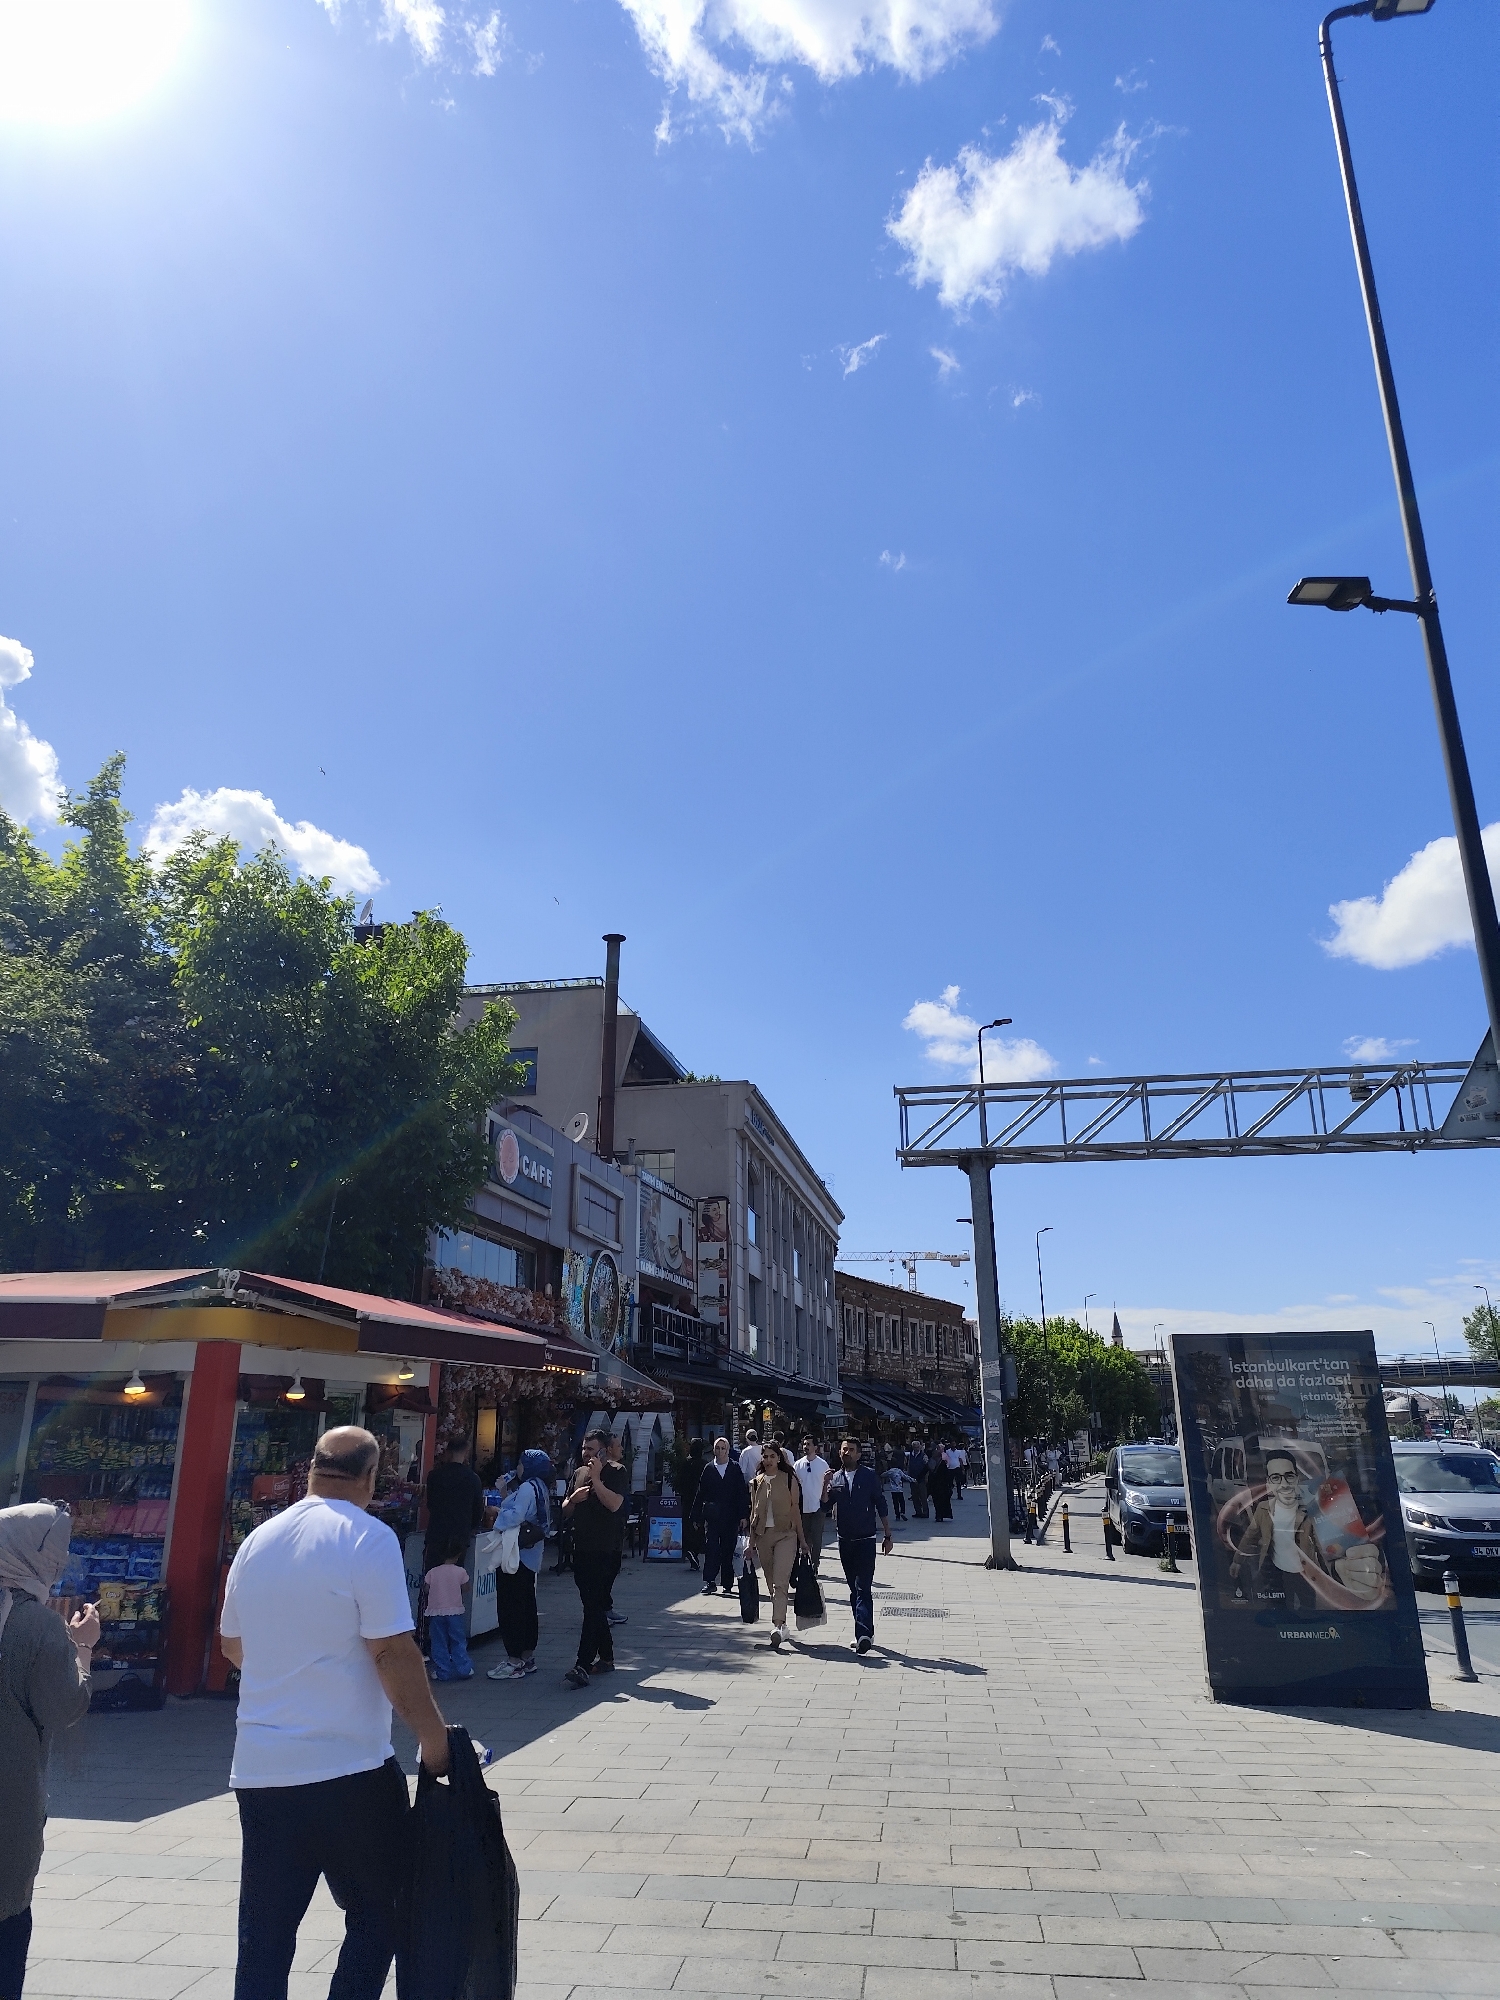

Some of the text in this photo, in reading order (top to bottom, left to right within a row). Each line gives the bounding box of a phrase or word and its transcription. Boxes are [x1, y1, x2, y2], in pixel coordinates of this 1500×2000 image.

[521, 1155, 553, 1189] CAFE
[1229, 1357, 1349, 1373] İstanbulkart'tan
[1235, 1373, 1351, 1389] daha da fazlası!
